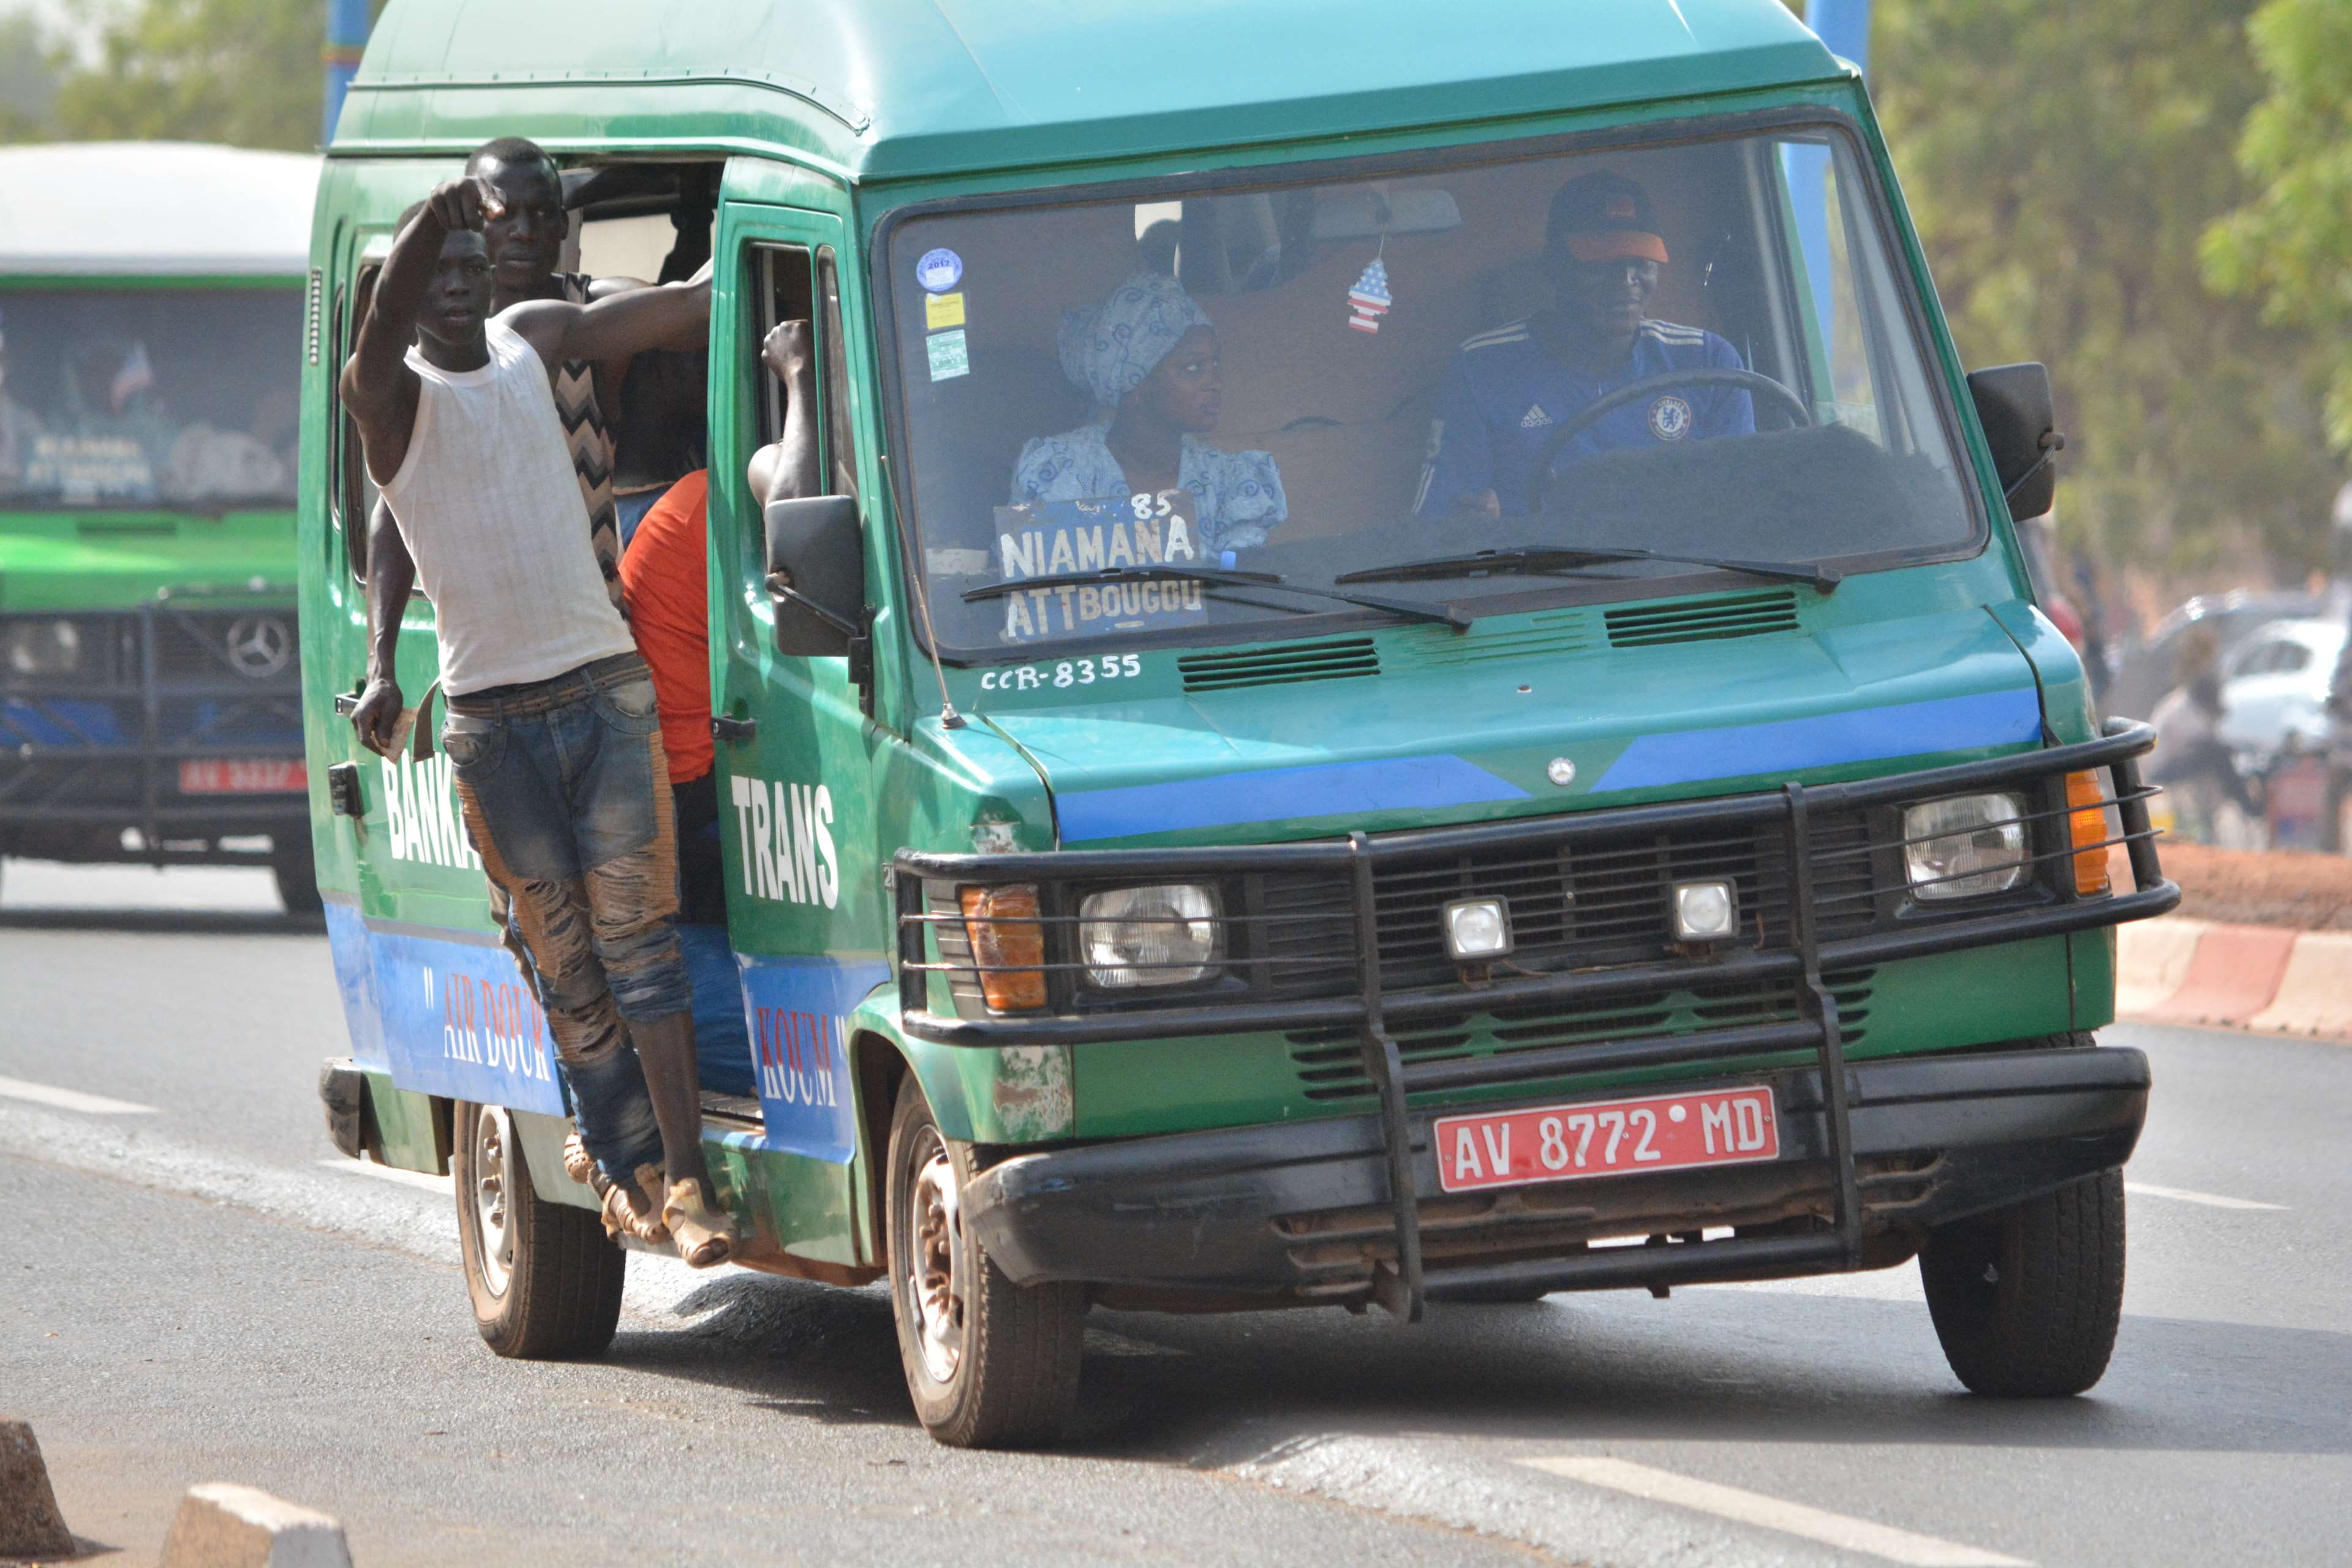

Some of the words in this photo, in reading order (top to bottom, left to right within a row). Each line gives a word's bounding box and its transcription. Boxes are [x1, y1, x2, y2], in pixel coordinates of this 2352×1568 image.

[928, 260, 949, 270] 2017
[1520, 416, 1553, 428] adidas
[1131, 489, 1180, 519] 85
[1000, 514, 1194, 578] NIAMANA
[981, 654, 1140, 690] CCR-8355
[731, 775, 839, 910] TRANS
[757, 1007, 837, 1107] KOUM
[1455, 1123, 1509, 1180] AV
[1539, 1109, 1661, 1170] 8772
[1700, 1097, 1765, 1155] MD
